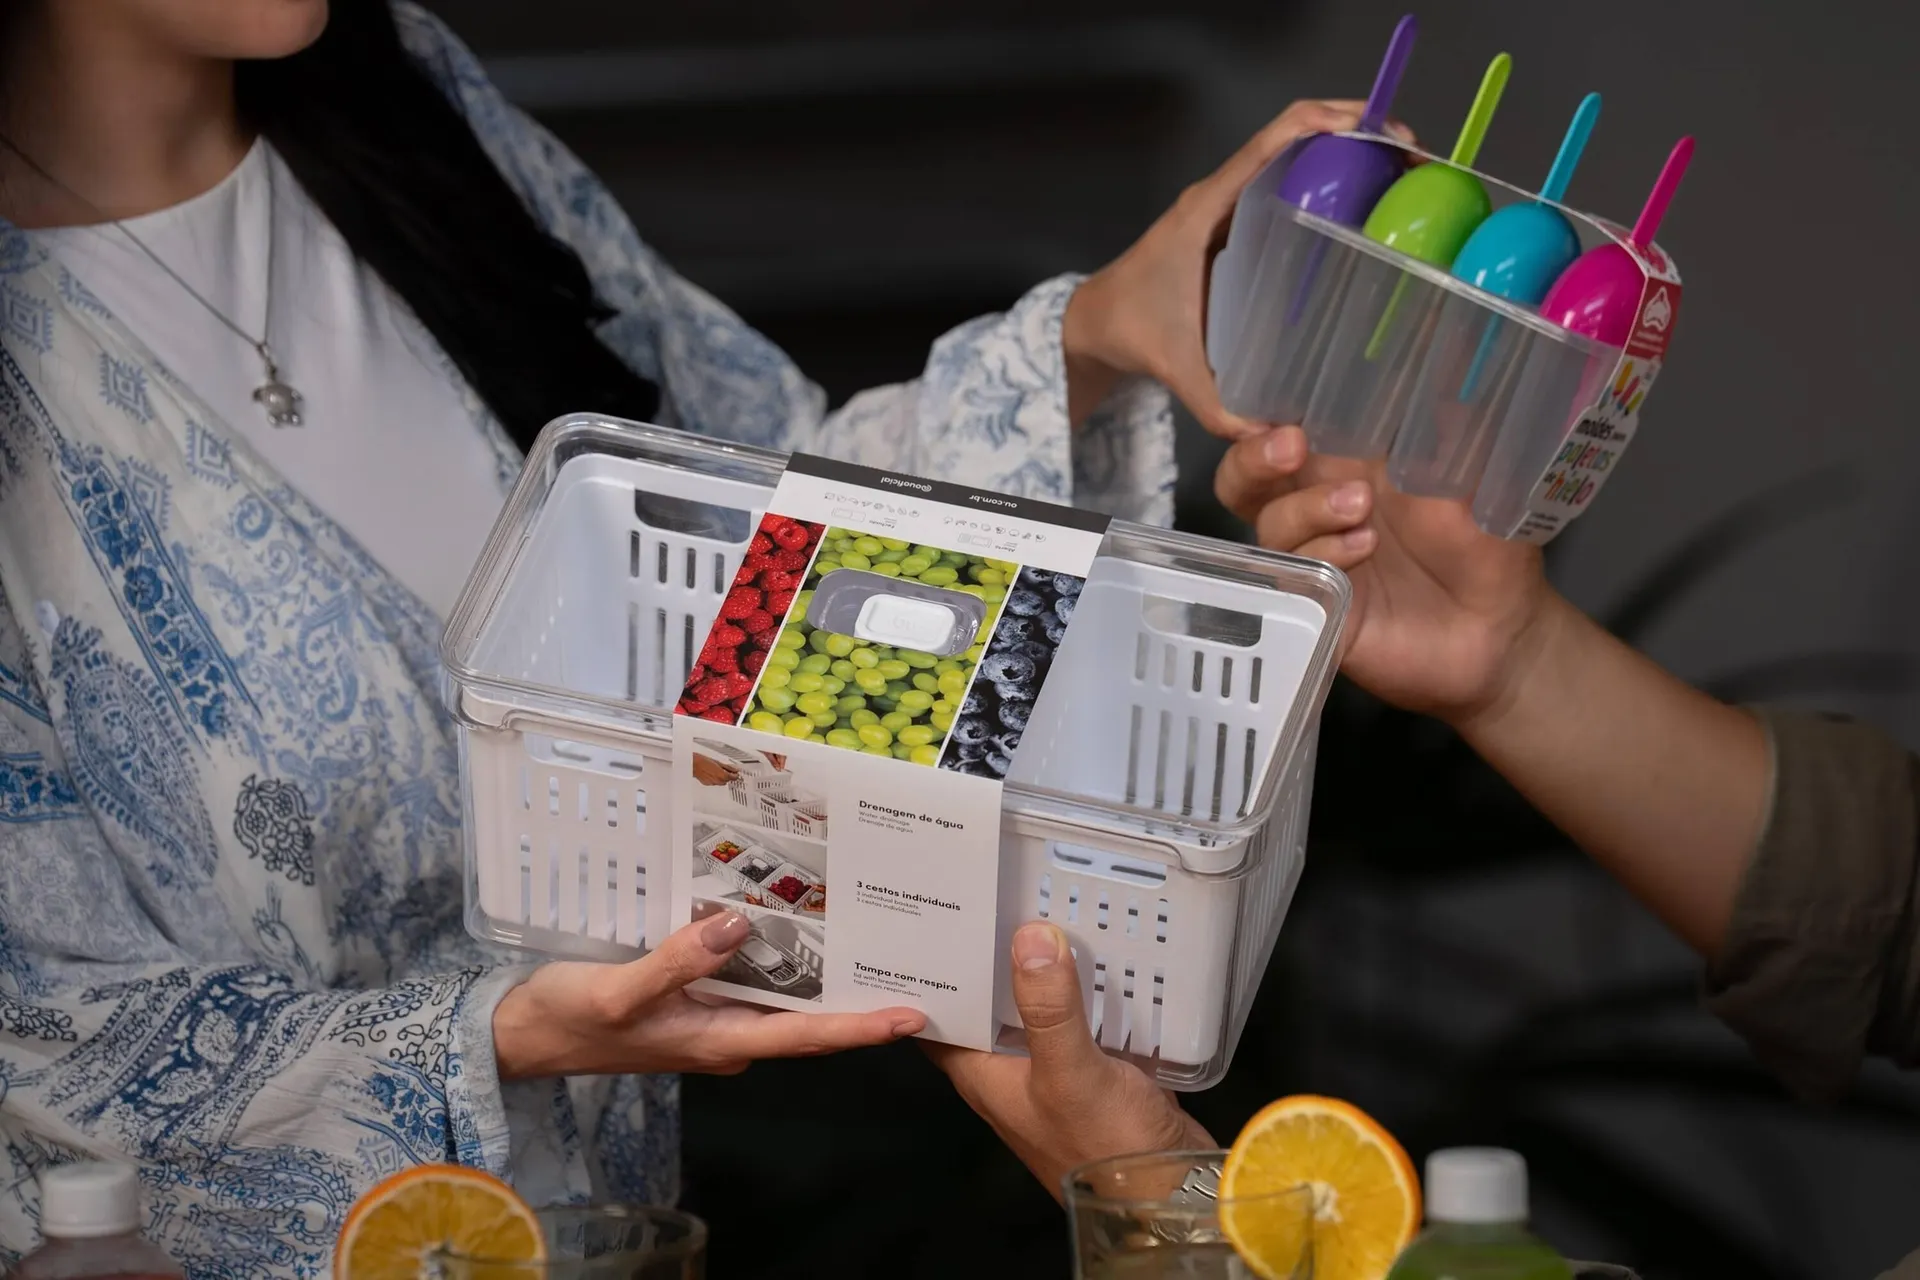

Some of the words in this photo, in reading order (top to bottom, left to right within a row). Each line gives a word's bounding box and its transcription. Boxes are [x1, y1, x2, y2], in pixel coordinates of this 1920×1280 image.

[881, 476, 932, 492] @ouoficial
[969, 494, 1018, 508] ou.com.br
[859, 800, 916, 819] Drenagem
[919, 814, 933, 823] de
[935, 816, 964, 829] água
[856, 880, 863, 888] 3
[865, 883, 900, 897] cestos
[902, 891, 961, 911] individuais
[854, 961, 891, 977] Tampa
[894, 972, 917, 983] com
[919, 977, 958, 992] respiro
